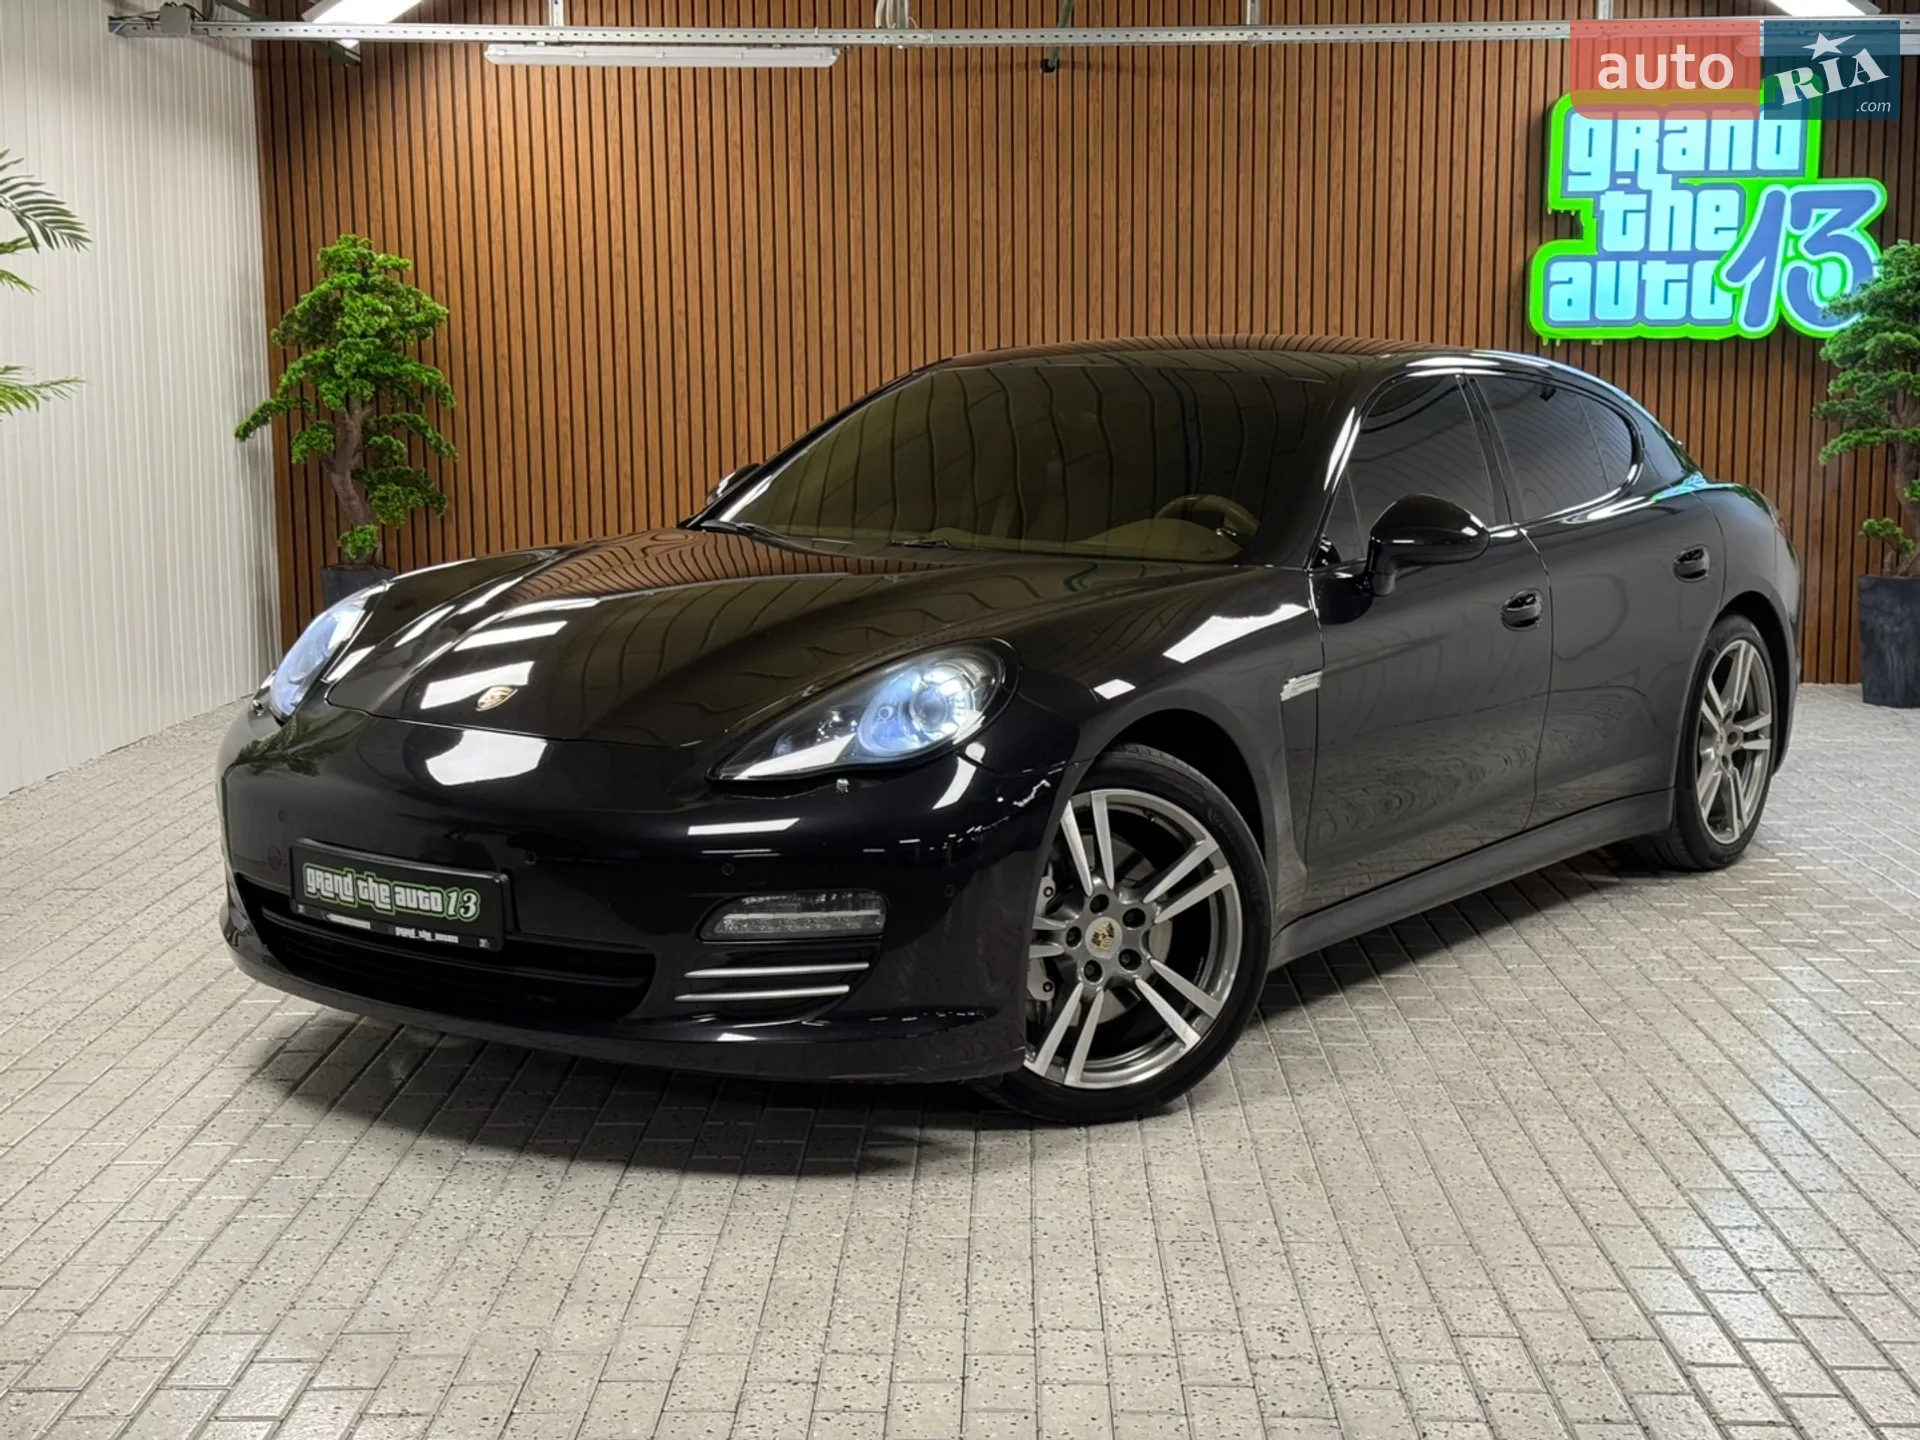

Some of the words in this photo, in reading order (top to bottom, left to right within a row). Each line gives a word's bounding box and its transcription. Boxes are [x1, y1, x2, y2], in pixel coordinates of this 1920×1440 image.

[1599, 174, 1740, 252] the
[1548, 260, 1737, 321] auto
[1719, 183, 1883, 332] 13
[357, 876, 392, 910] the
[394, 885, 443, 913] auto
[446, 889, 479, 919] 13
